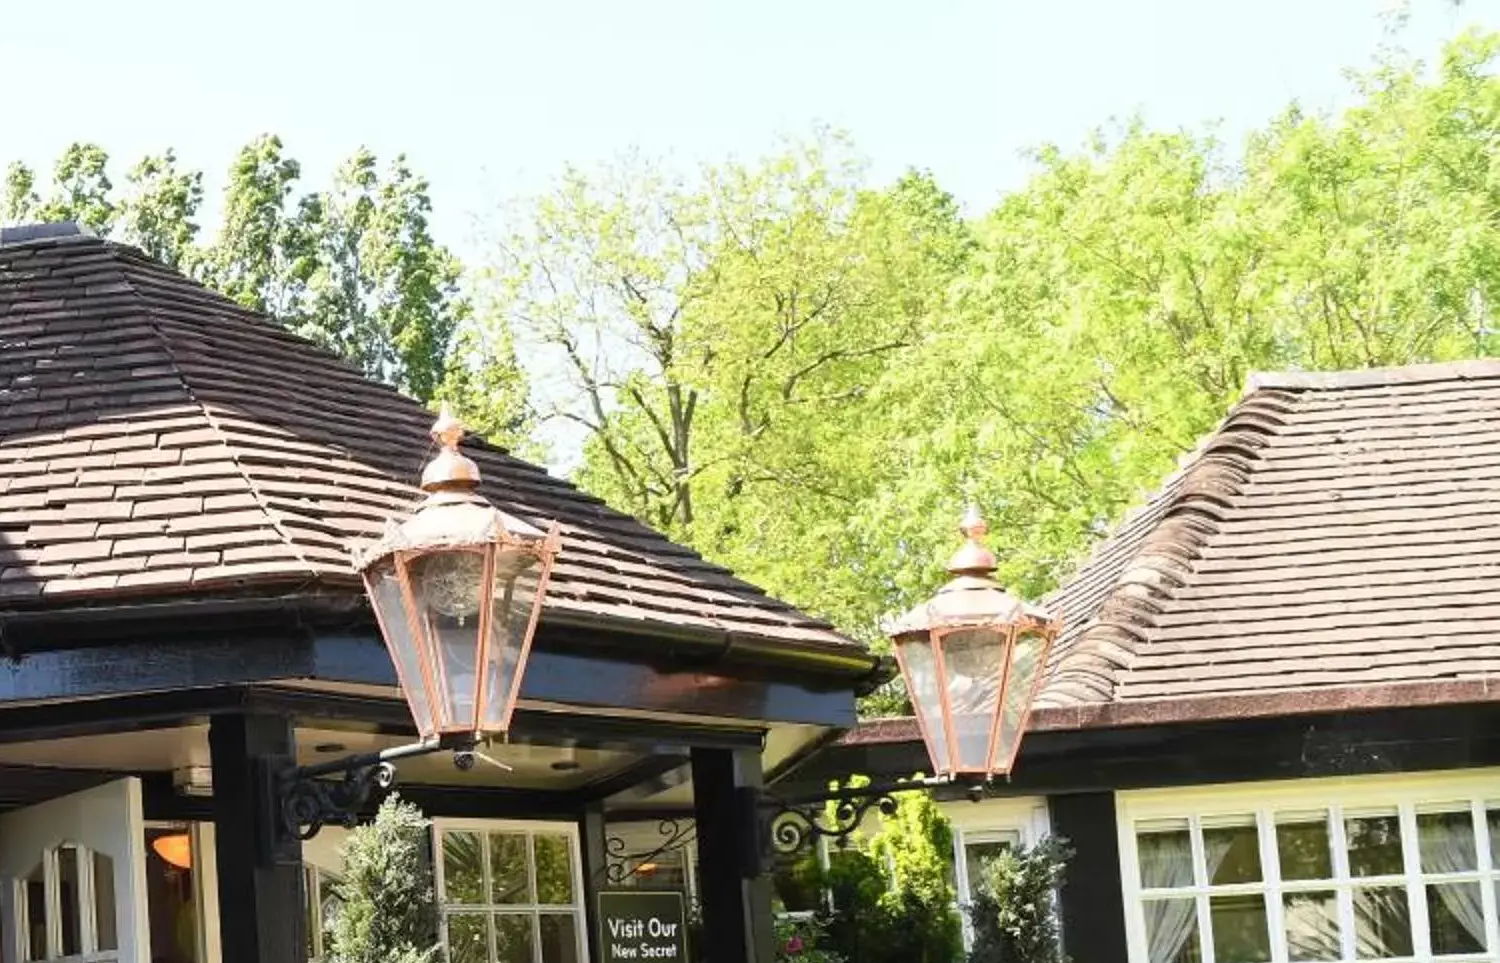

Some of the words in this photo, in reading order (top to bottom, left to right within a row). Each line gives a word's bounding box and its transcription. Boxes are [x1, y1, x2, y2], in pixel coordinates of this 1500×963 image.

[608, 918, 644, 939] Visit
[648, 917, 677, 937] Our
[612, 943, 637, 958] New
[641, 942, 676, 957] Secret
